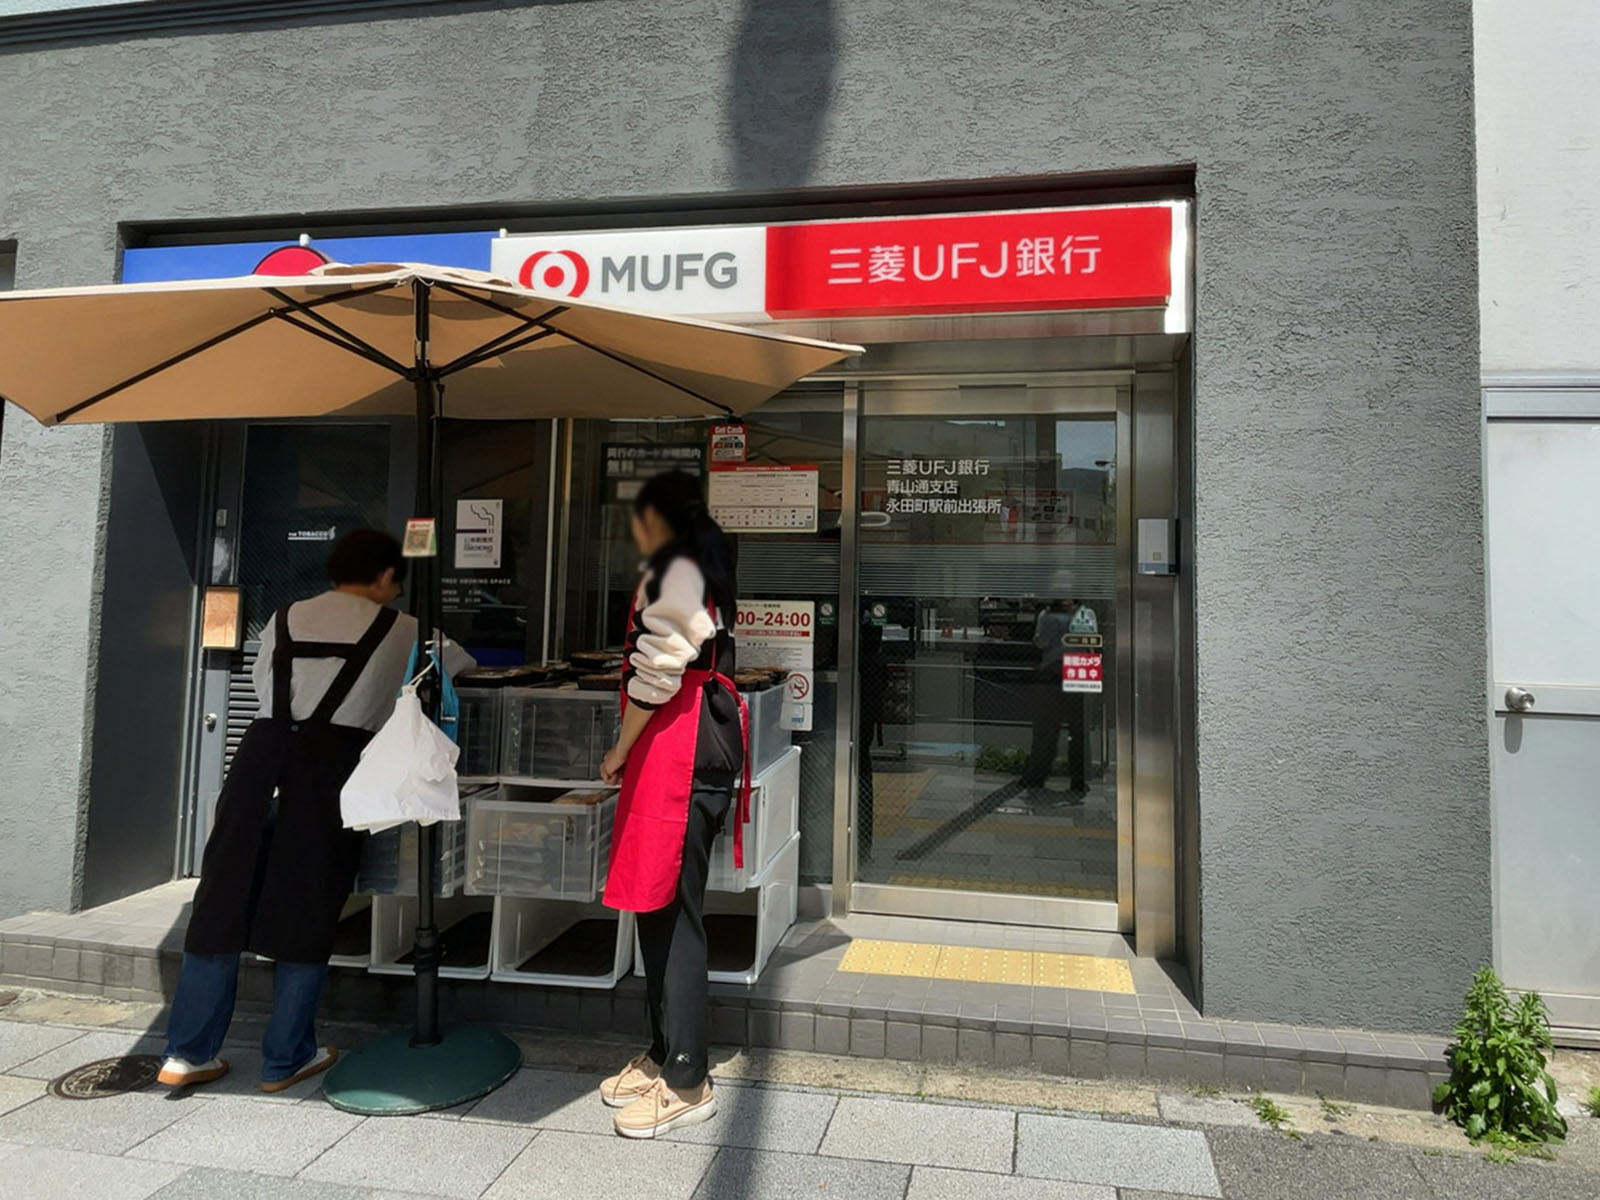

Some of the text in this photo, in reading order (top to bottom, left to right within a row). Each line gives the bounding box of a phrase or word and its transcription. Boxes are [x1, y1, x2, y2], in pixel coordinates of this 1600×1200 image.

[828, 235, 1102, 284] 三菱UFJ銀行
[601, 252, 738, 293] MUFG
[886, 459, 990, 475] 三菱UFJ銀行
[886, 479, 959, 494] 青山通支店
[886, 498, 1002, 514] 永田町駅前出張所
